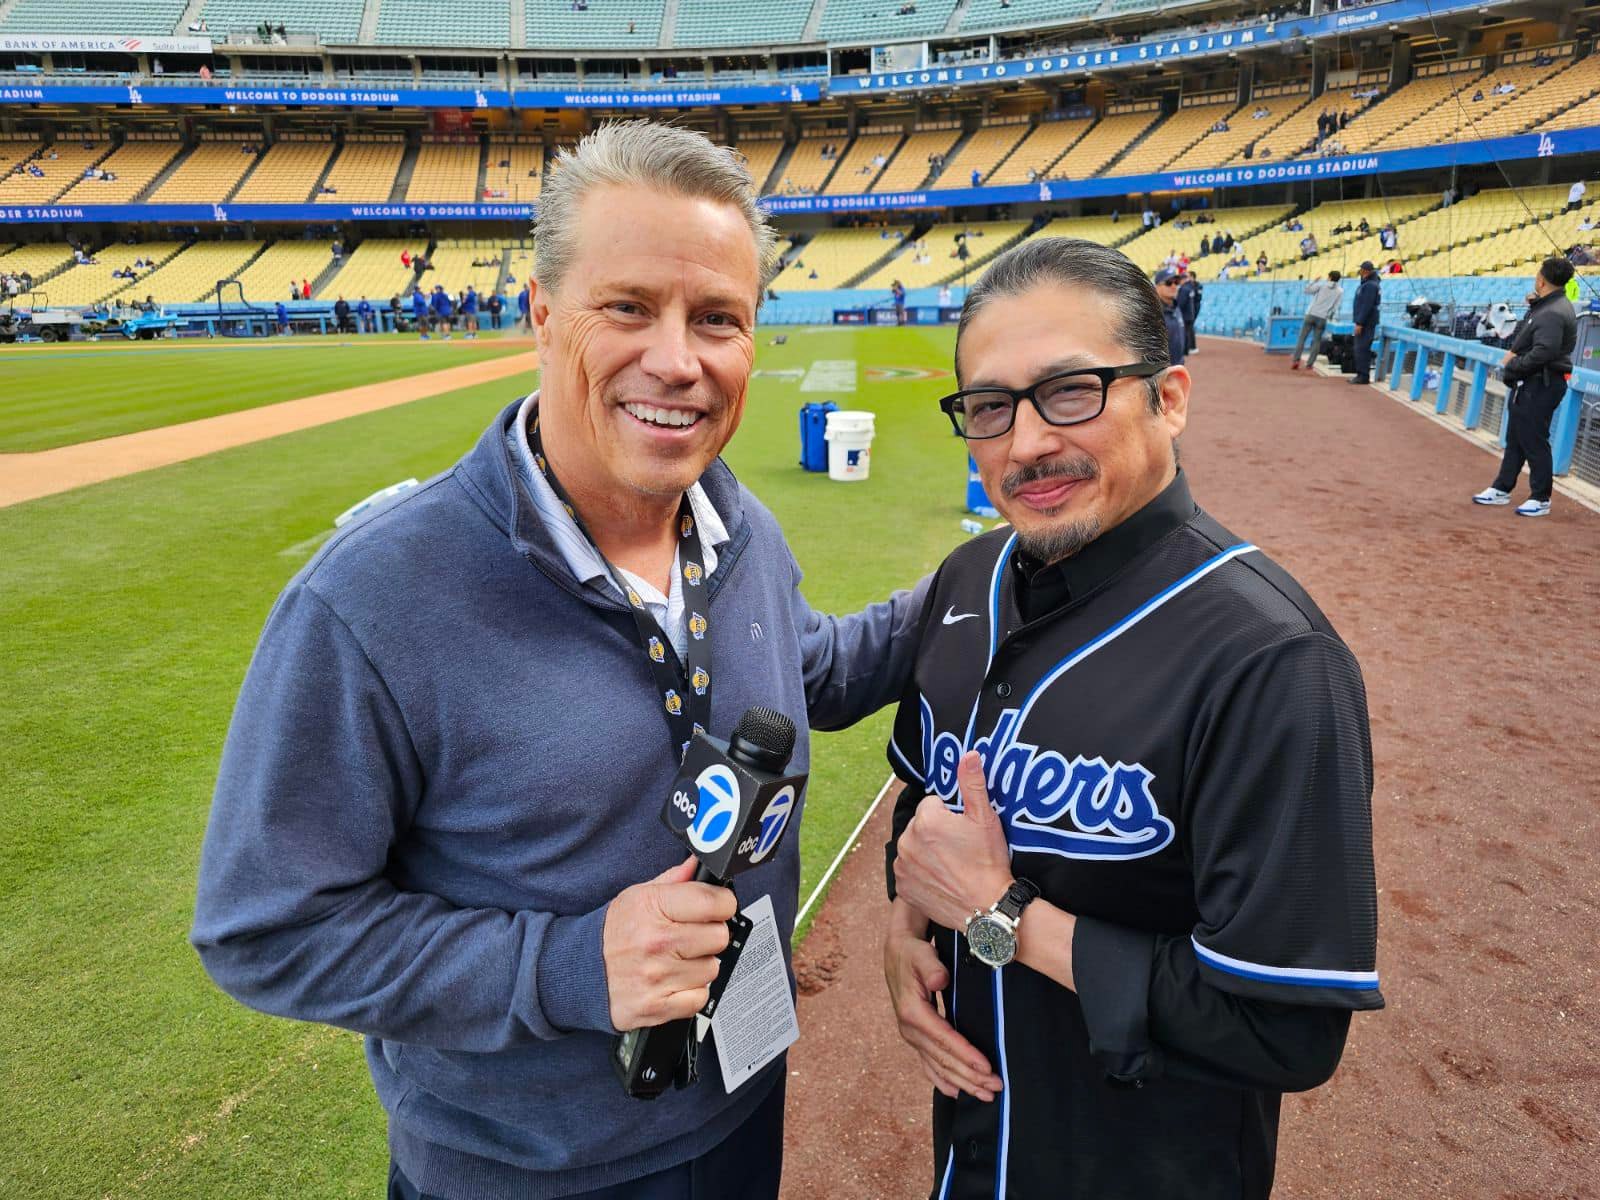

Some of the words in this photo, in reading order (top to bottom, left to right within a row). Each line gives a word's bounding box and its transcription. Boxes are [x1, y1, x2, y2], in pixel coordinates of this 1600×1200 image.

[5, 40, 38, 49] BANK
[42, 41, 57, 49] OF
[61, 40, 116, 50] AMERICA
[858, 69, 963, 88] WELCOME
[981, 64, 1006, 78] TO
[1025, 50, 1119, 73] DODGER
[1139, 31, 1254, 59] STADIUM
[225, 91, 279, 100] WELCOME
[282, 91, 297, 100] TO
[302, 92, 346, 101] DODGER
[351, 93, 399, 102] STADIUM
[565, 95, 613, 104] WELCOME
[616, 95, 629, 104] TO
[633, 94, 673, 103] DODGER
[677, 93, 721, 102] STADIUM
[1538, 132, 1555, 157] LA
[1174, 172, 1232, 186] WELCOME
[1237, 171, 1253, 181] TO
[1258, 164, 1312, 179] DODGER
[1317, 157, 1379, 173] STADIUM
[763, 199, 811, 210] WELCOME
[815, 199, 829, 208] TO
[879, 194, 927, 206] STADIUM
[27, 209, 84, 218] STADIUM
[352, 207, 407, 216] WELCOME
[410, 207, 426, 216] TO
[430, 207, 476, 216] DODGER
[481, 207, 531, 216] STADIUM
[673, 790, 697, 819] abc
[686, 764, 741, 853] 7
[738, 835, 760, 856] abc
[749, 785, 796, 864] 7
